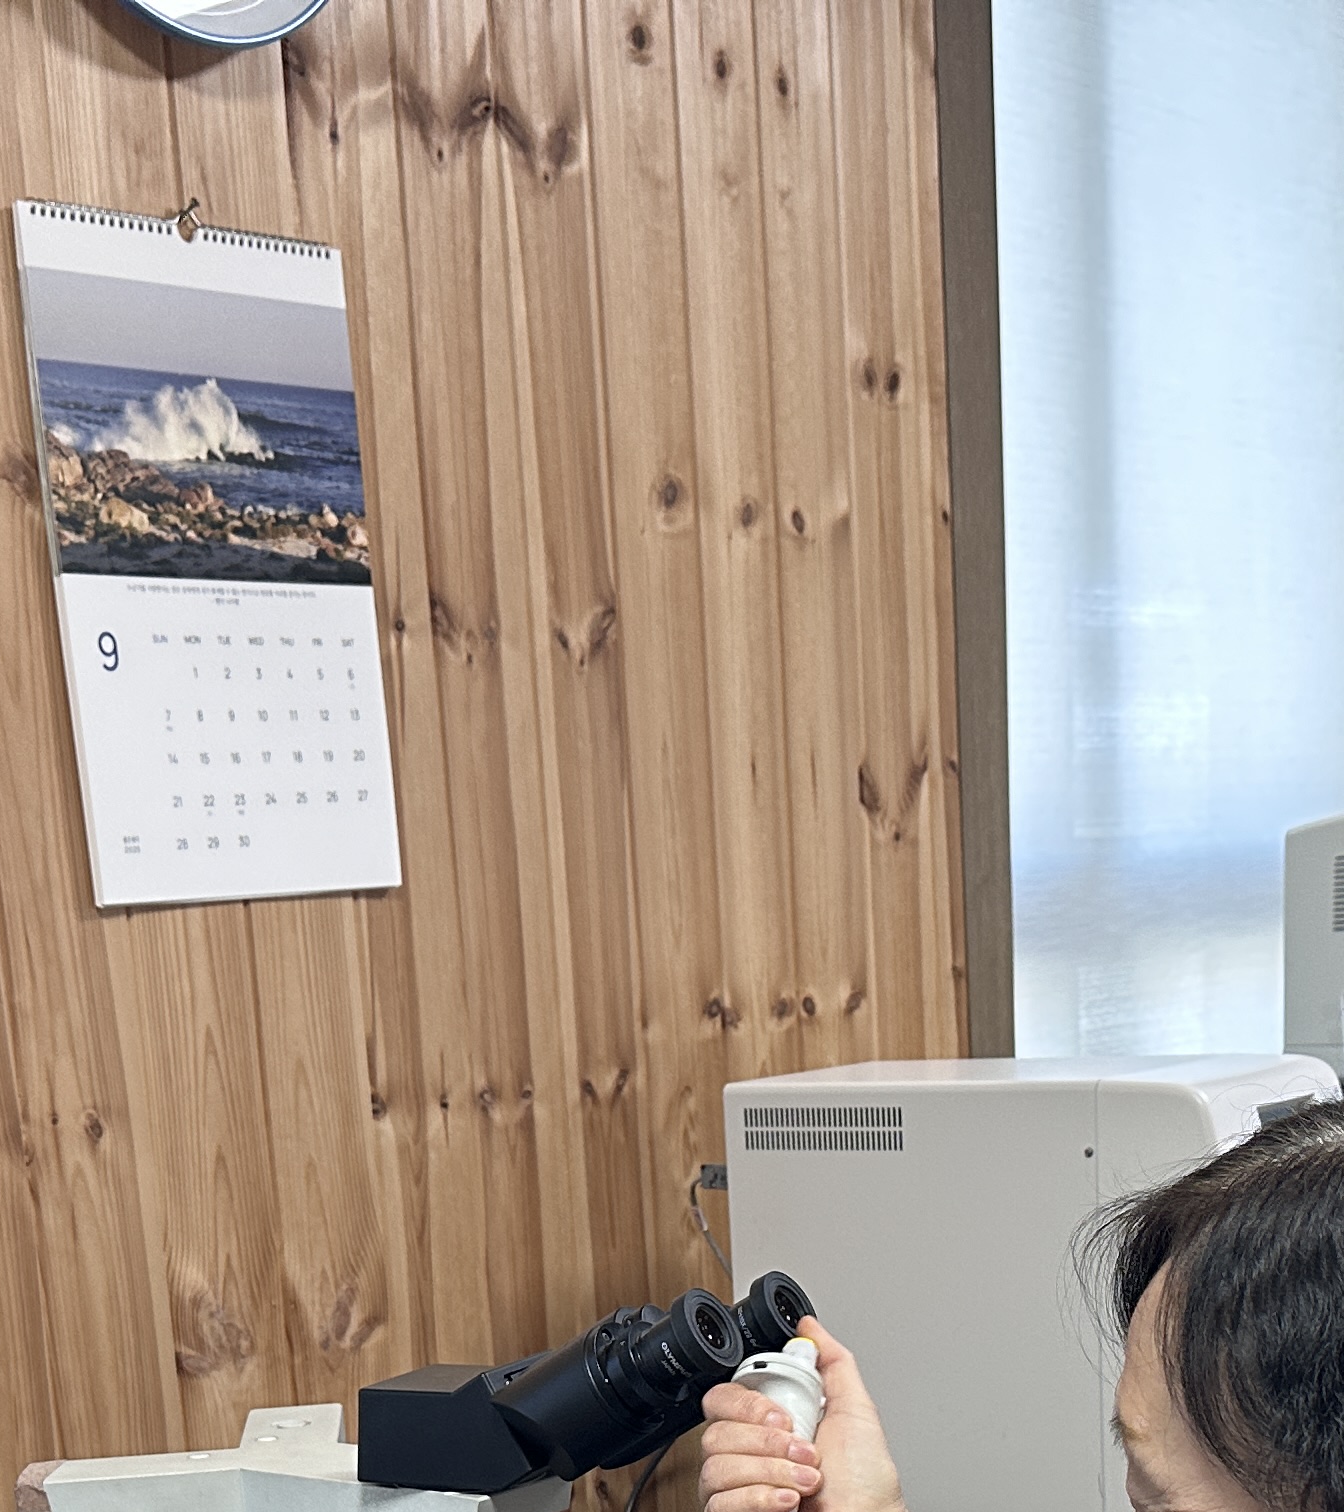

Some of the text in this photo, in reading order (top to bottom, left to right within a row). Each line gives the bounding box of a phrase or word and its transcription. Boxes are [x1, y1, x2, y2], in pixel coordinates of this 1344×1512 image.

[184, 634, 202, 644] MON
[217, 635, 232, 645] TUE
[248, 635, 264, 646] WED
[98, 631, 119, 671] 9
[193, 667, 355, 681] 1 2 3 4 5 6
[165, 709, 361, 722] 7 8 9 10 11 12 13
[168, 750, 366, 765] 14 15 16 17 18 19 20
[173, 790, 369, 808] 21 22 23 24 25 26 27
[177, 835, 251, 850] 28 29 30
